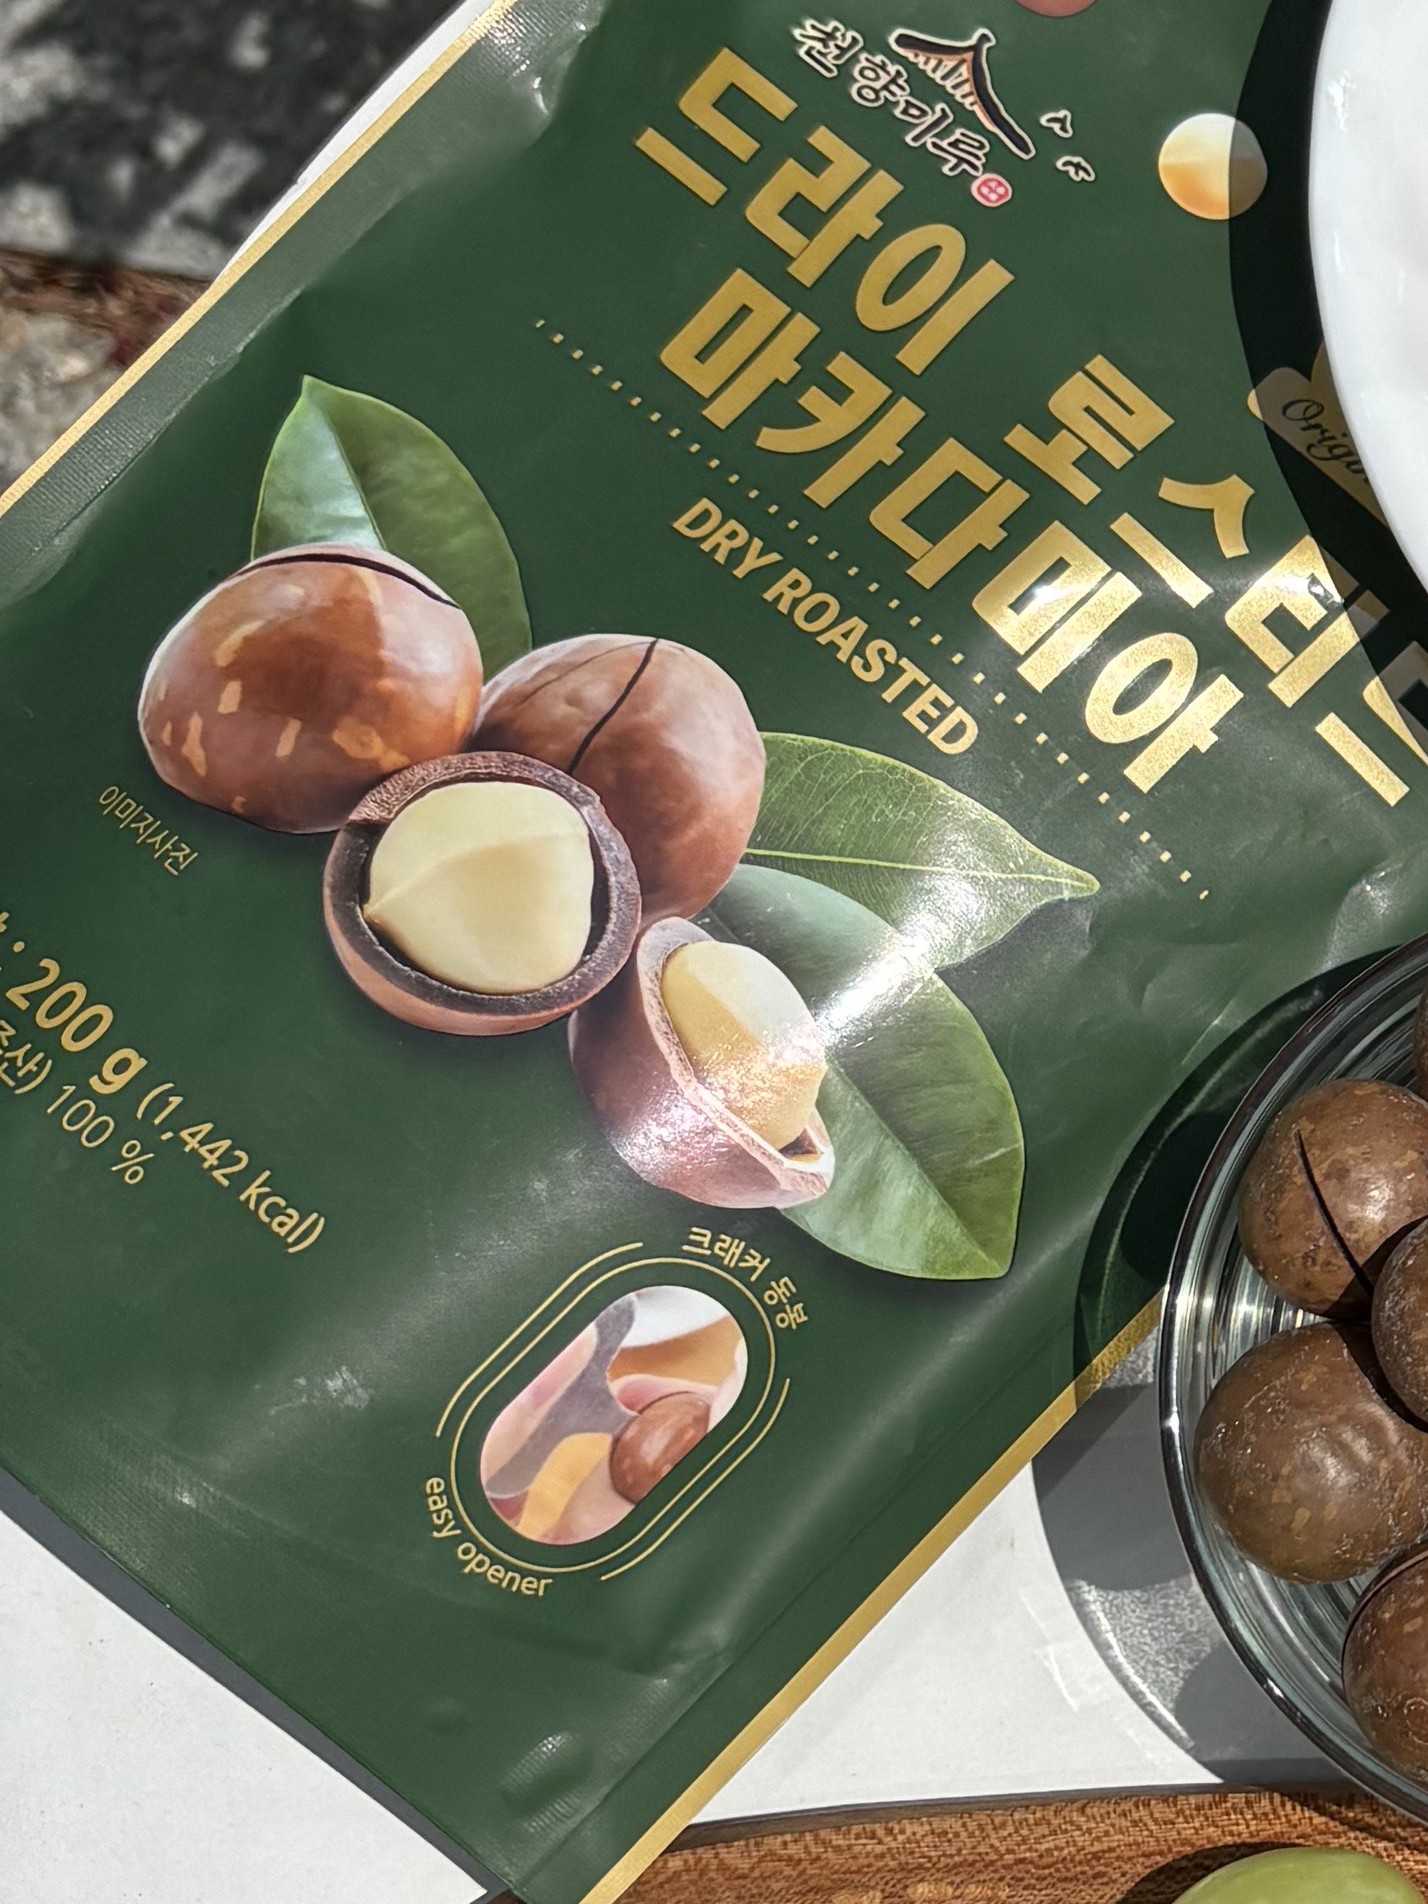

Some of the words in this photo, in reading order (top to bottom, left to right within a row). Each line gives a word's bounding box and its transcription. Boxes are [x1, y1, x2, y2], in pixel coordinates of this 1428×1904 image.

[636, 47, 1015, 375] 드라이
[659, 267, 1243, 793] 마카다미아
[672, 497, 782, 582] DRY
[762, 569, 980, 756] ROASTED
[99, 785, 198, 876] 이미지사진
[5, 958, 114, 1053] 200
[89, 1048, 148, 1094] g
[136, 1083, 249, 1187] (1,442
[239, 1169, 326, 1254] kcal)
[47, 1085, 115, 1149] 100
[111, 1140, 156, 1185] %
[682, 1226, 771, 1282] 크래커
[763, 1276, 810, 1330] 동봉
[425, 1476, 461, 1539] easy
[457, 1541, 553, 1597] opener
